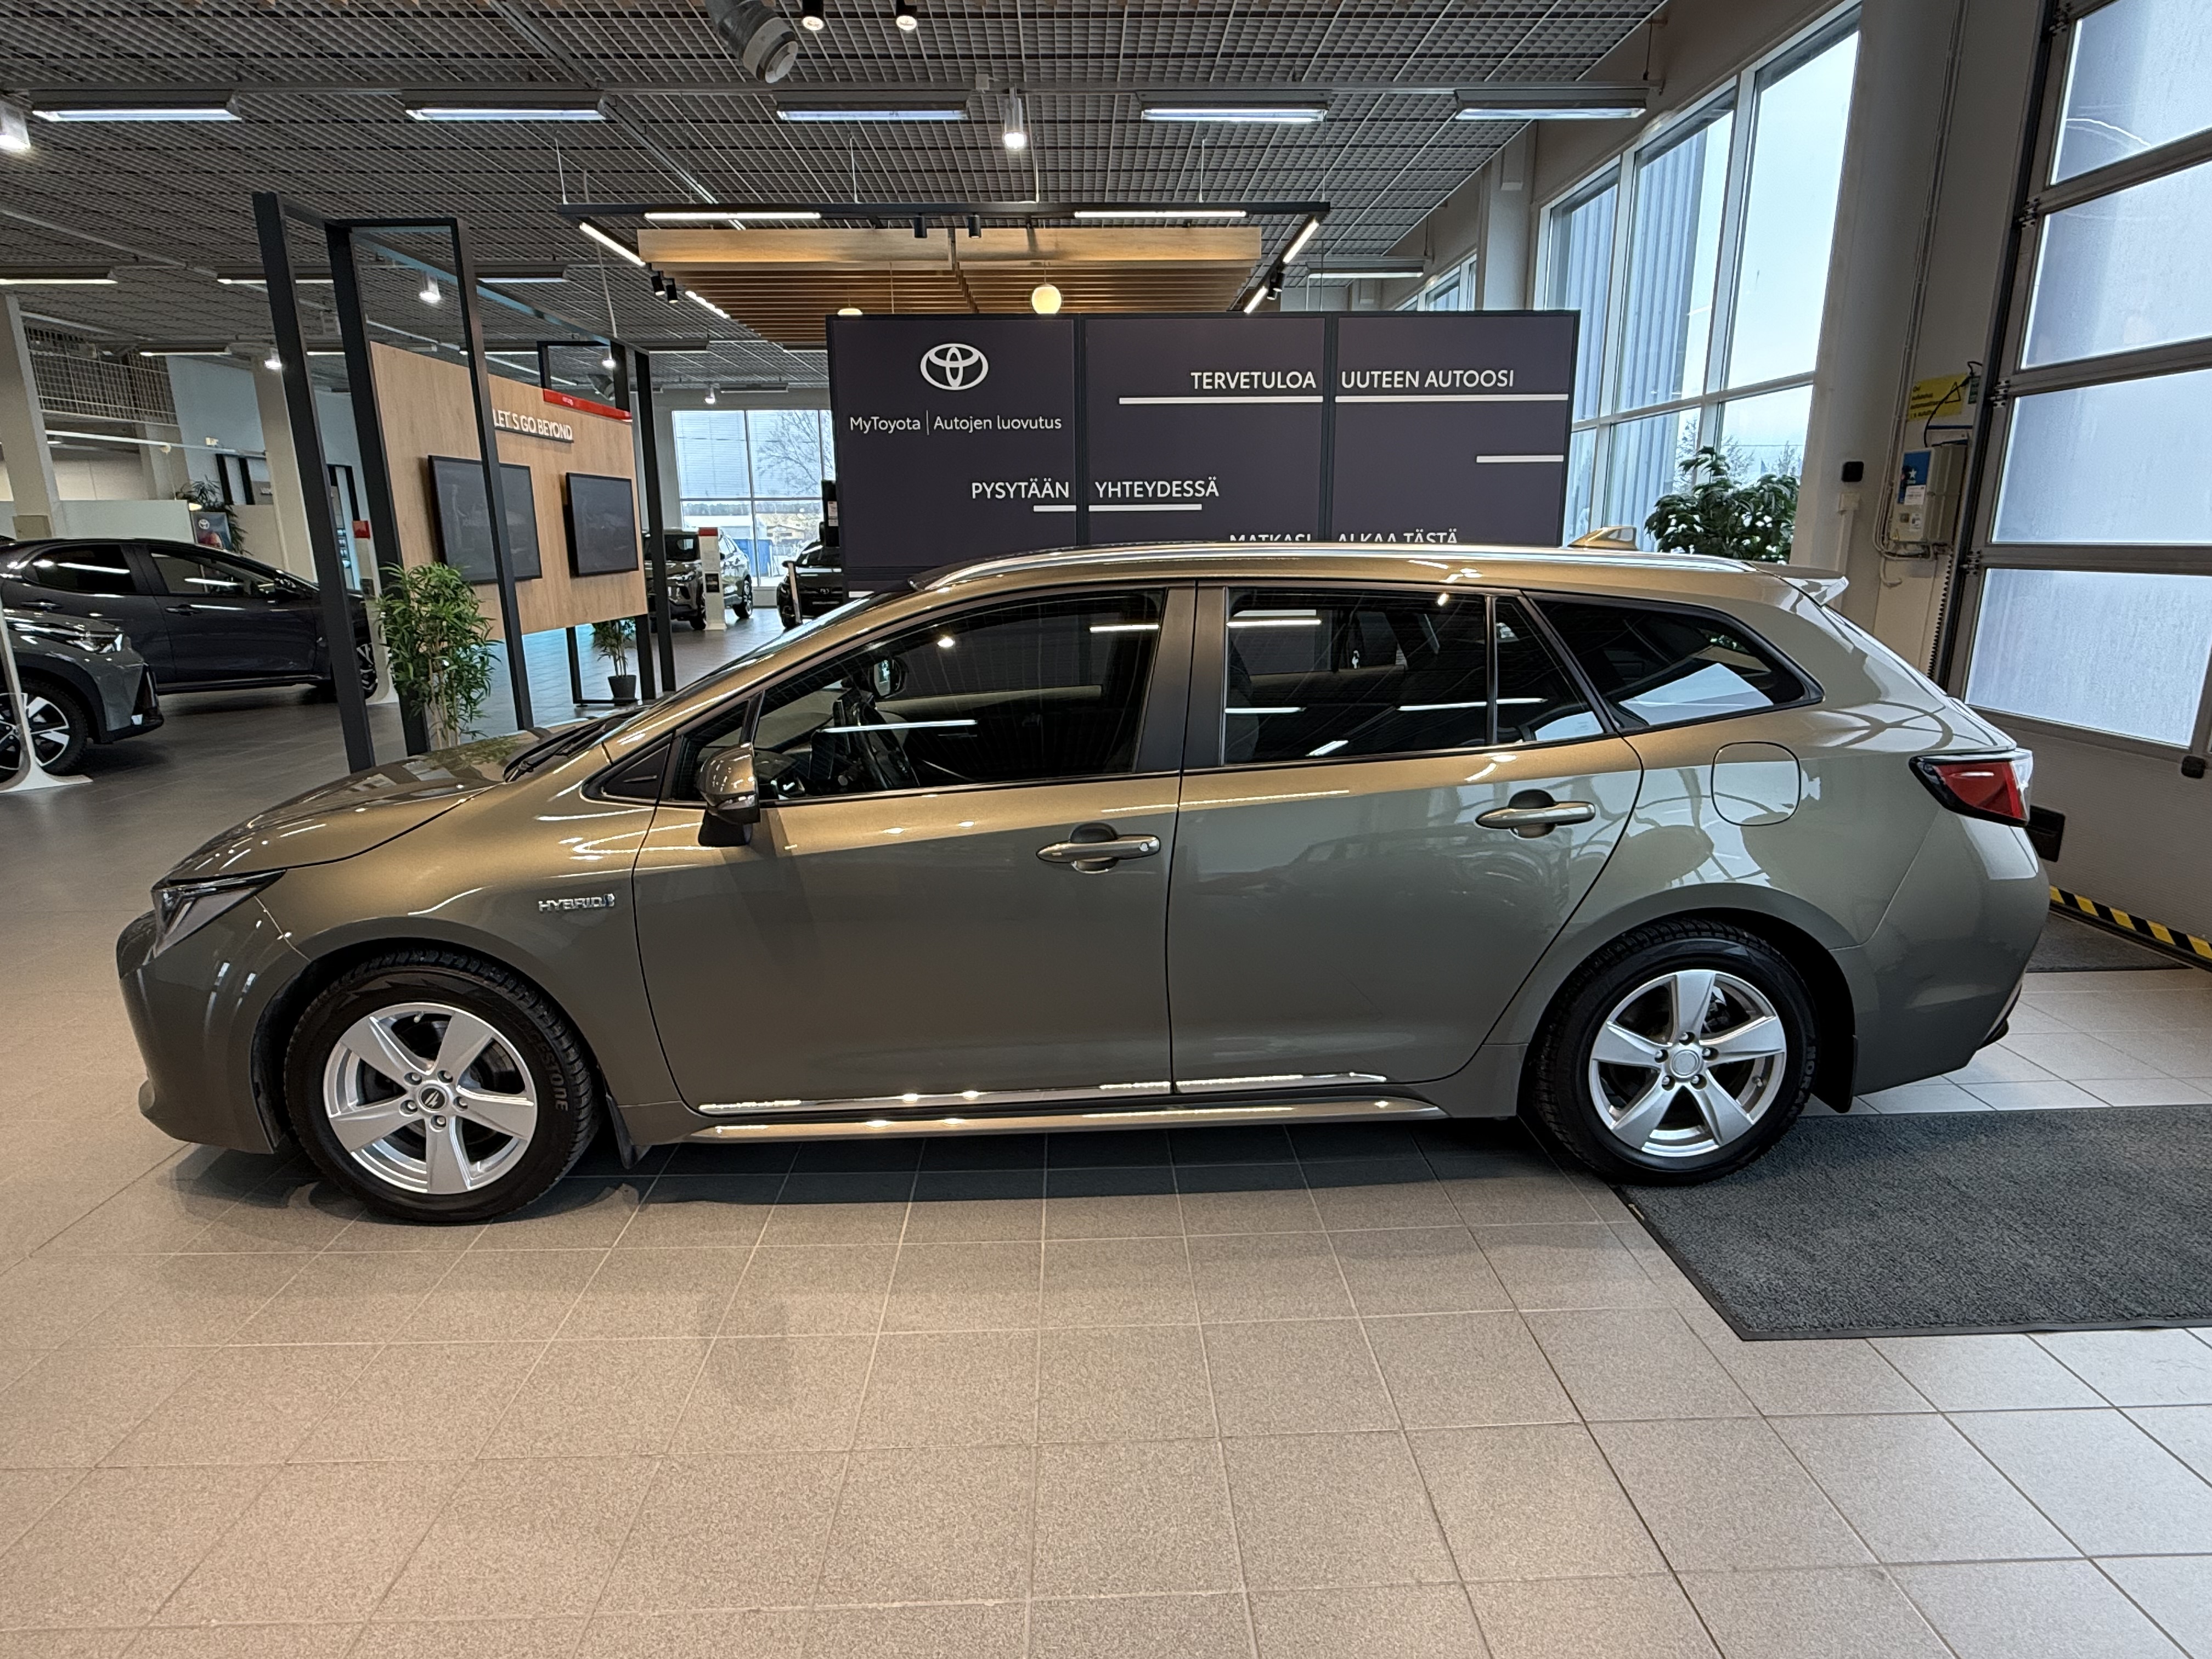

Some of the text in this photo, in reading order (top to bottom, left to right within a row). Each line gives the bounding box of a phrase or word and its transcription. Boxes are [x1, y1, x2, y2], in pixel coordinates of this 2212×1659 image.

[1190, 370, 1514, 390] TERVETULOA UUTEEN AUTOOSI
[520, 415, 537, 434] GO
[537, 418, 573, 441] BEYOND
[850, 415, 1062, 434] MyToyota Autojen luovutus
[971, 476, 1219, 499] PYSYTÄÄN YHTEYDESSÄ
[538, 896, 603, 912] HYBRID
